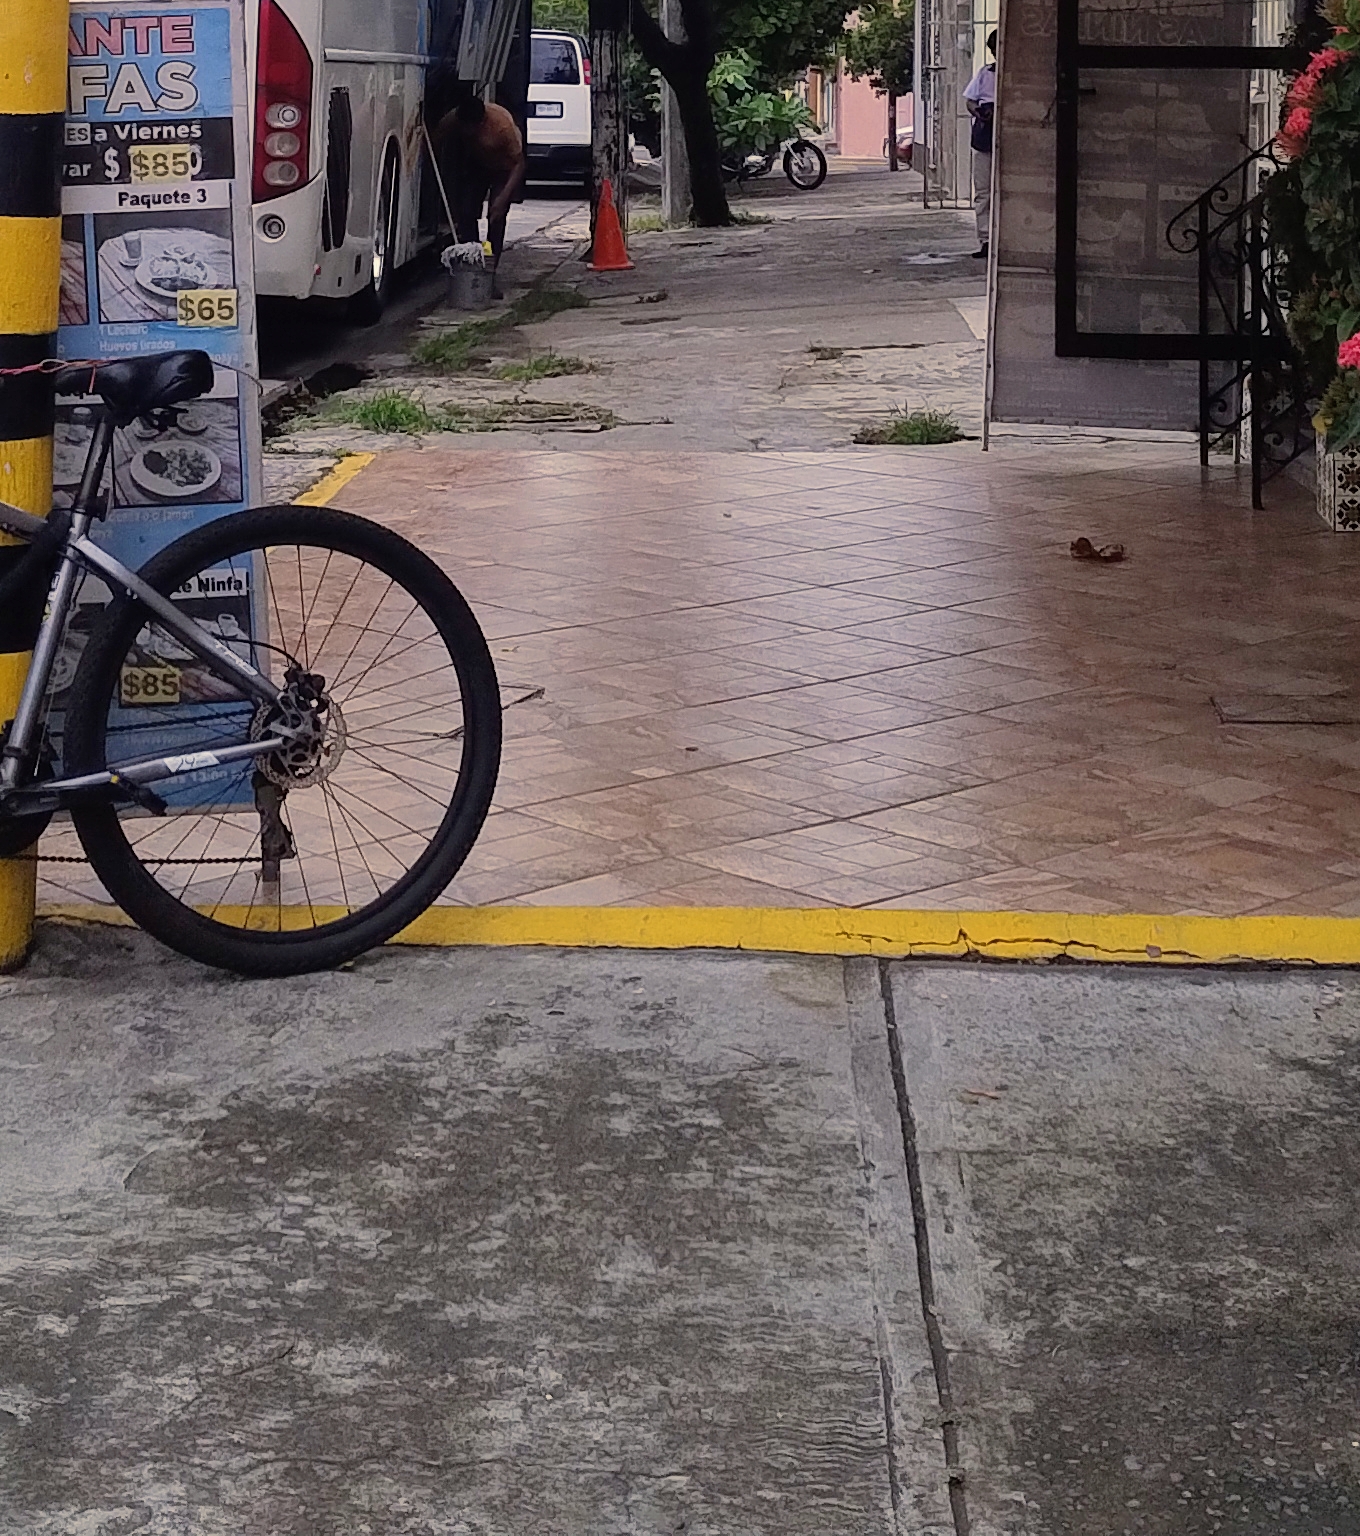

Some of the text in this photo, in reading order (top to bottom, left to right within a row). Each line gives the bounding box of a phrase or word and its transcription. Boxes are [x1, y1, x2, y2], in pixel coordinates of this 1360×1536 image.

[94, 125, 108, 142] a
[114, 121, 203, 141] Viernes
[132, 150, 189, 181] $85
[118, 188, 207, 209] Paquete 3
[178, 294, 235, 326] $65
[198, 576, 244, 593] Ninfa
[123, 671, 179, 698] $85
